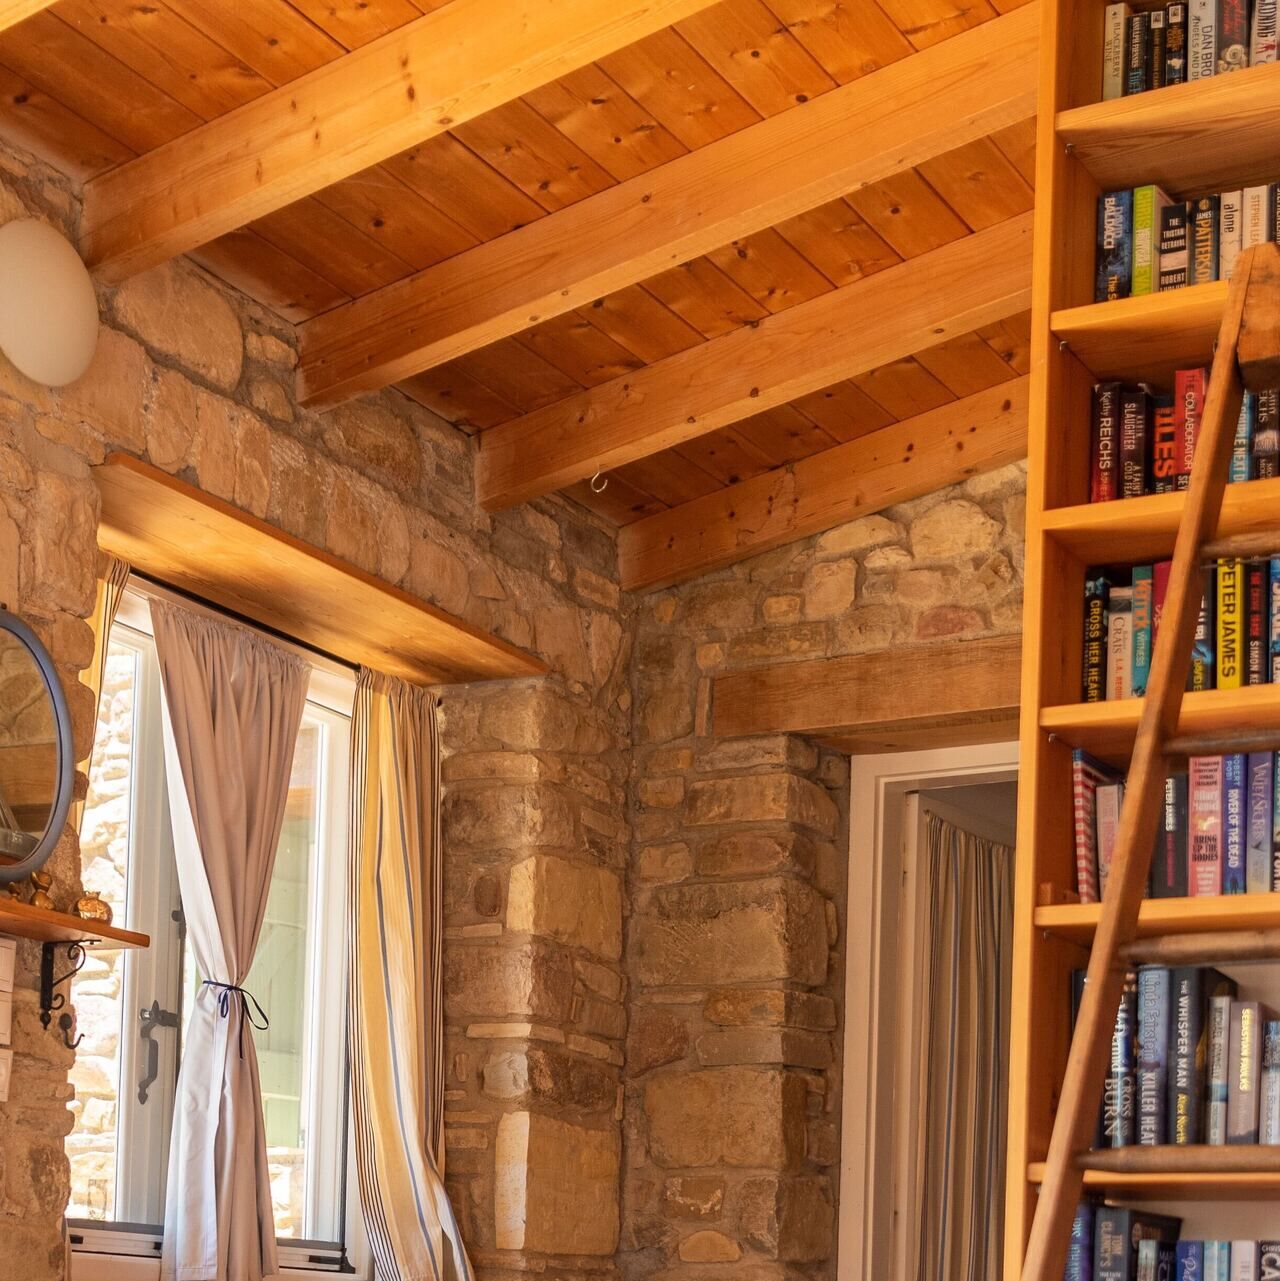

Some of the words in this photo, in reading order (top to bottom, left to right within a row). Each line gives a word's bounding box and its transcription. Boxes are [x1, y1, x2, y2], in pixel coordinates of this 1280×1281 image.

[1104, 40, 1113, 64] WINE
[1111, 22, 1122, 79] BLACKBERRY
[1200, 25, 1213, 50] DAN
[1103, 197, 1116, 249] BALDACCI
[1222, 203, 1239, 233] alone
[1249, 194, 1261, 228] STEPHEN
[1098, 418, 1111, 469] REICHS
[1123, 403, 1137, 451] SLAUGHTER
[1183, 391, 1196, 470] COLLABORATOR
[1089, 599, 1102, 638] CROSS
[1089, 641, 1101, 665] HER
[1134, 631, 1147, 667] WITNESS
[1221, 619, 1237, 678] JAMES
[1249, 640, 1262, 671] SIMON
[1176, 995, 1190, 1055] WHISPER
[1239, 1007, 1254, 1056] SEBASTIAN
[1141, 1071, 1157, 1113] KILLER
[1176, 1057, 1189, 1088] MAN
[1238, 1057, 1251, 1092] FAULKS
[1103, 1078, 1120, 1137] BURN
[1140, 1115, 1156, 1145] HEAT
